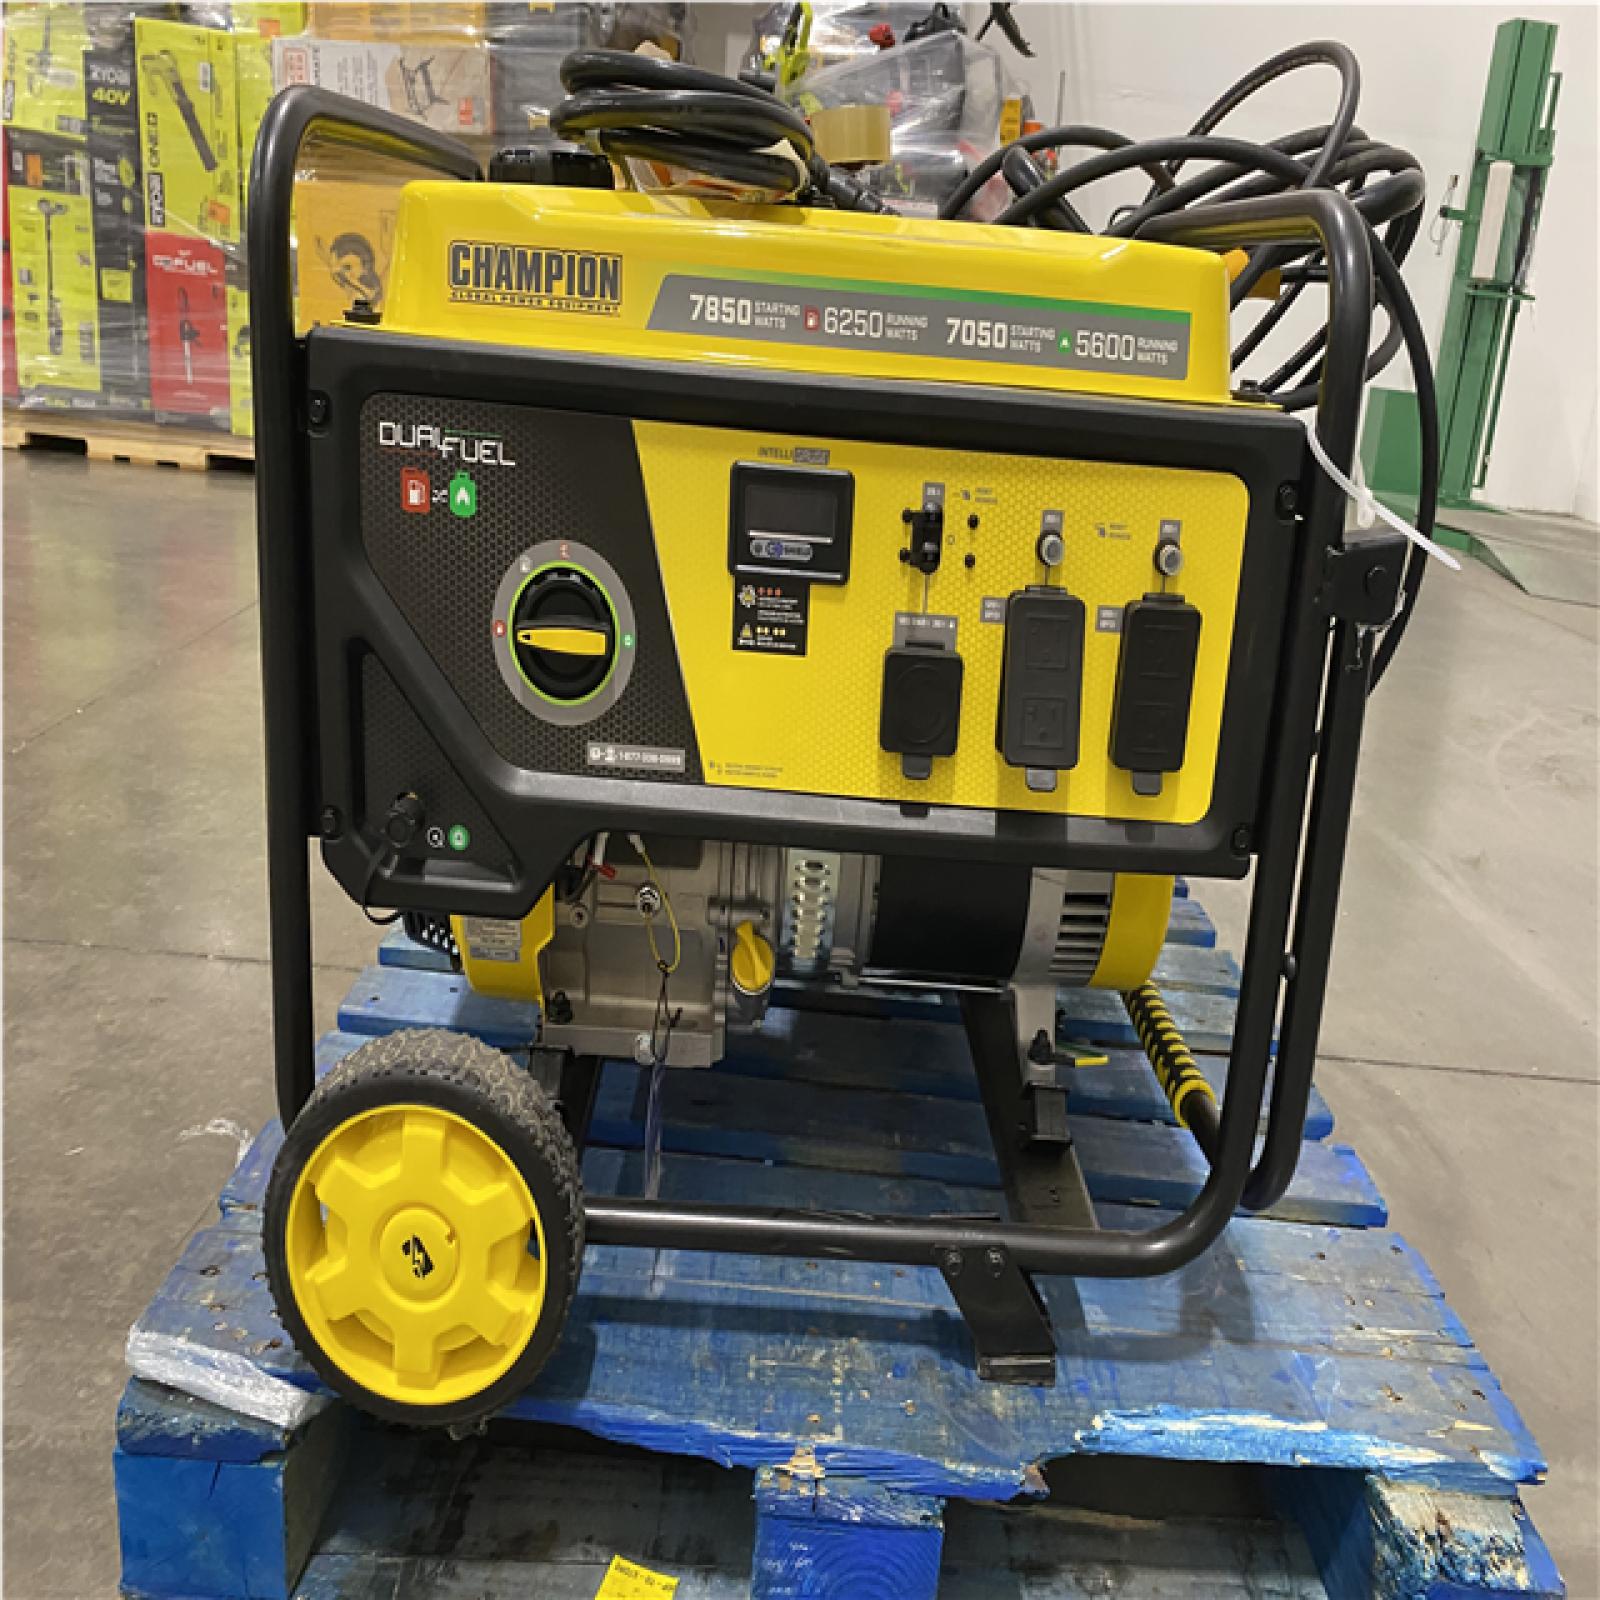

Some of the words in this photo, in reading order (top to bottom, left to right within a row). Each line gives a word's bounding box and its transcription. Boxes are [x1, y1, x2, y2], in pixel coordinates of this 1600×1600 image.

[451, 243, 620, 302] CHAMPION
[689, 294, 751, 326] 7850
[754, 300, 801, 316] STARTING
[754, 316, 786, 330] WATTS
[824, 306, 883, 338] 6250
[946, 317, 1008, 348] 7050
[1075, 329, 1136, 361] 5600
